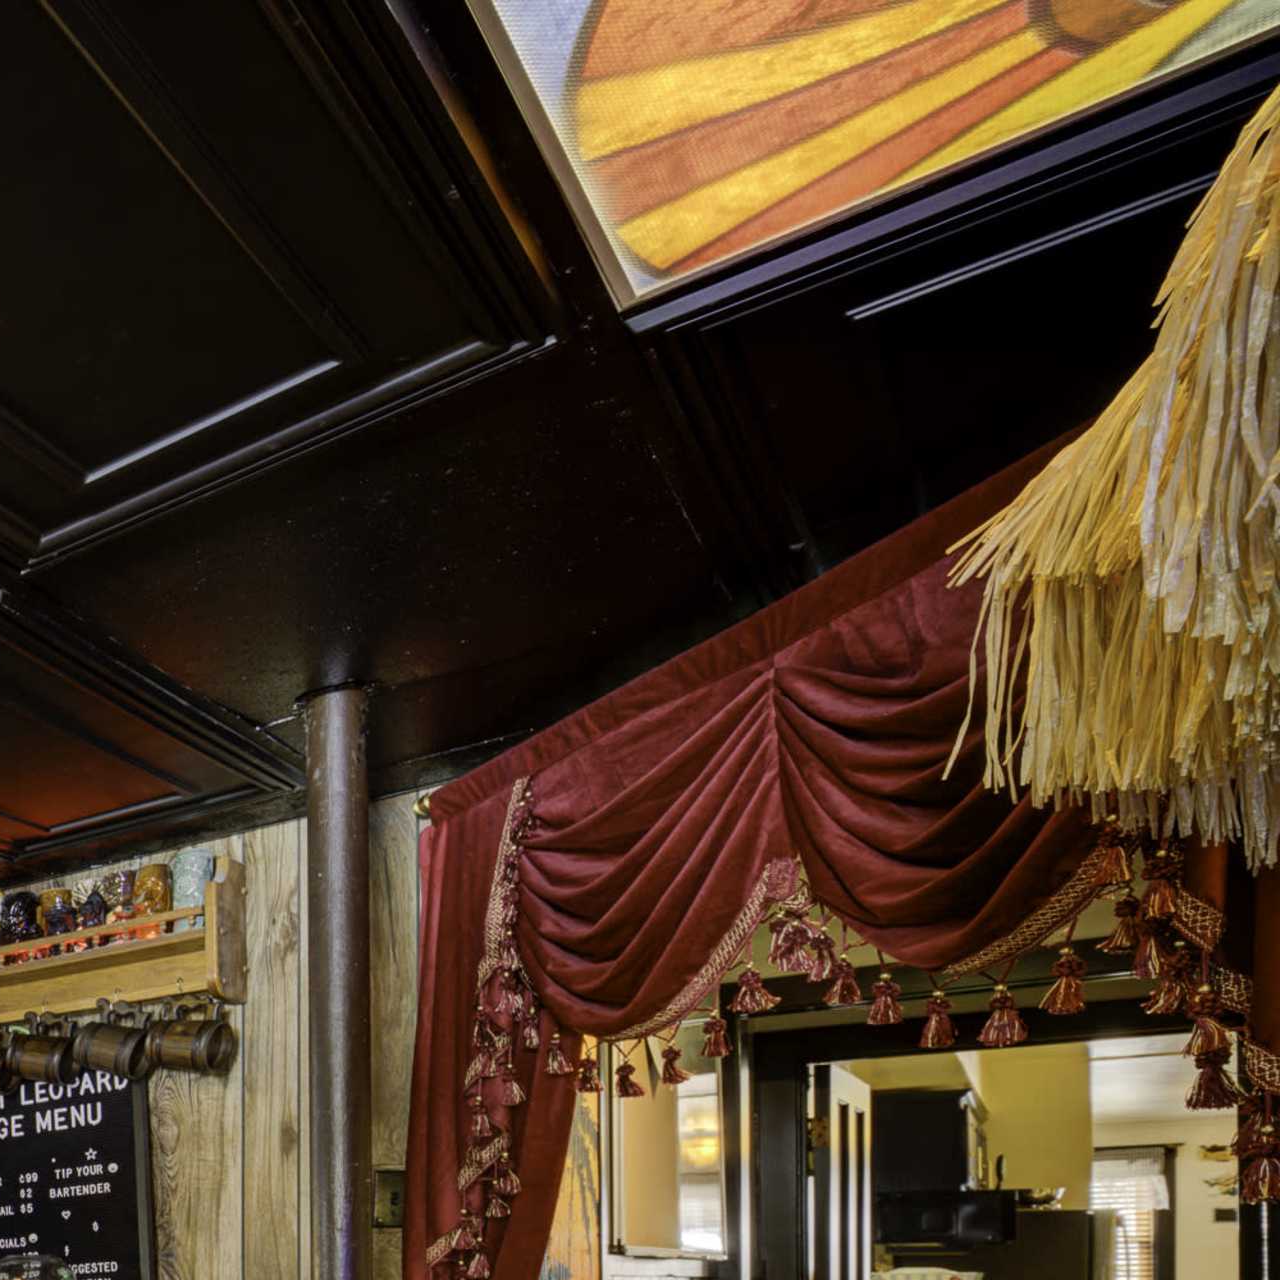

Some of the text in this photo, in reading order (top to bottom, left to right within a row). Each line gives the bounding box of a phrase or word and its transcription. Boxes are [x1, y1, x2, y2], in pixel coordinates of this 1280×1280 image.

[20, 1070, 128, 1106] LEOPARD
[35, 1102, 102, 1134] MENU
[54, 1164, 103, 1180] TIP YOUR
[49, 1182, 111, 1199] BARTENDER
[20, 1203, 34, 1214] $5
